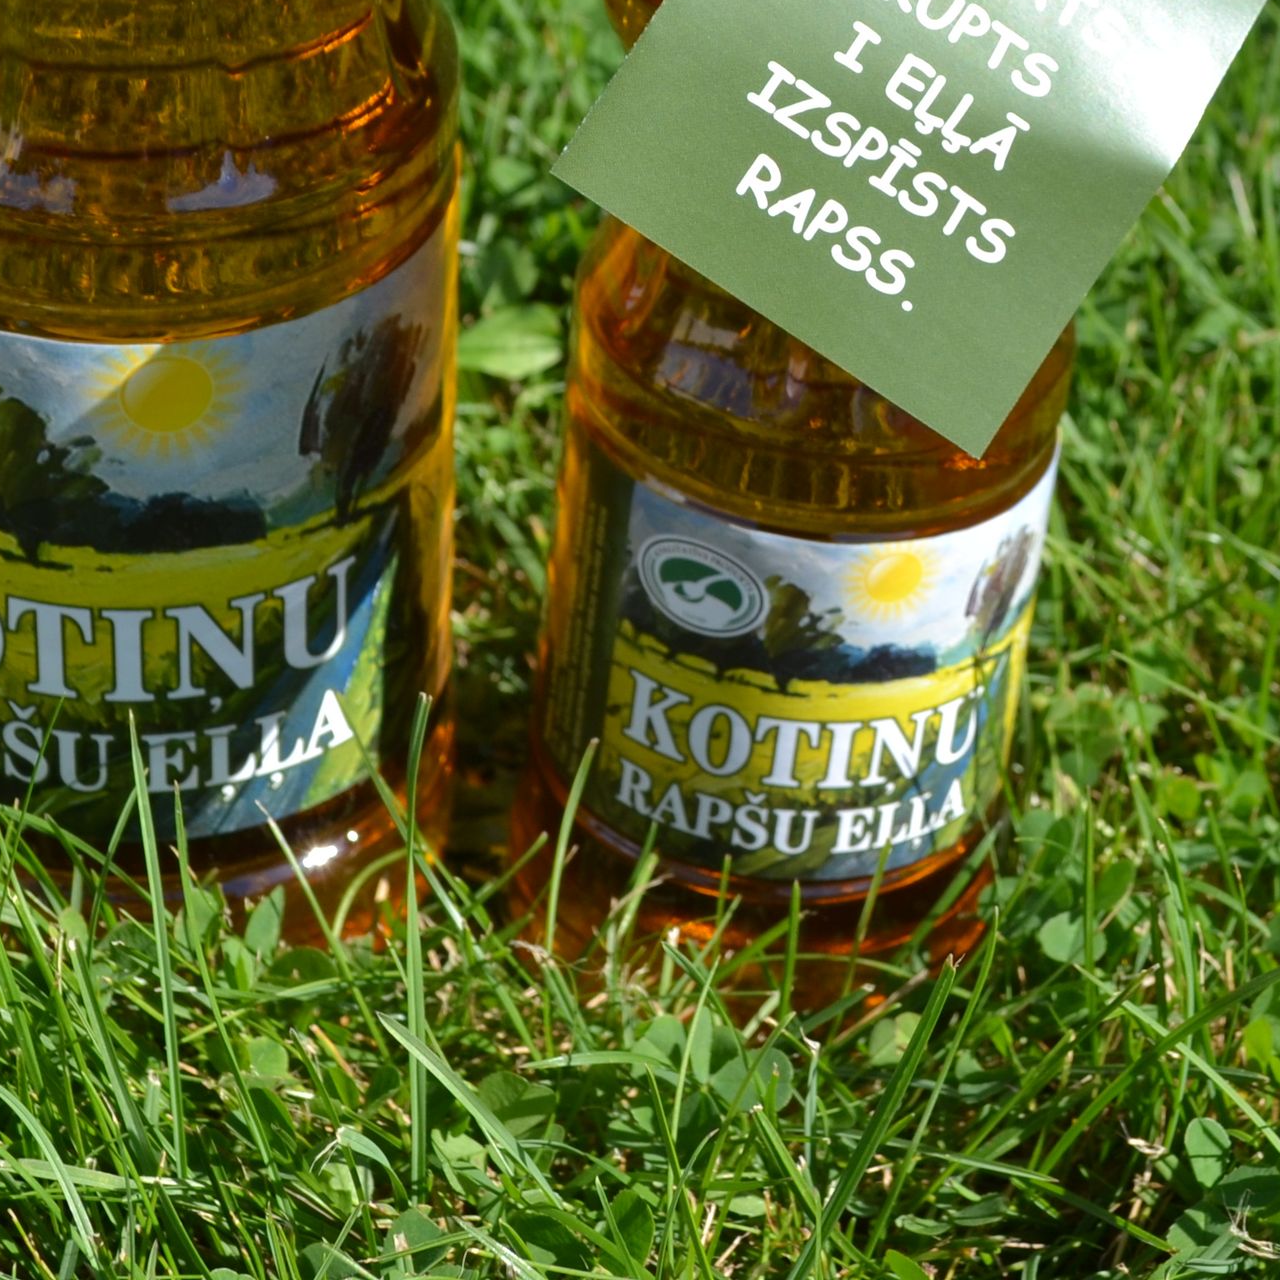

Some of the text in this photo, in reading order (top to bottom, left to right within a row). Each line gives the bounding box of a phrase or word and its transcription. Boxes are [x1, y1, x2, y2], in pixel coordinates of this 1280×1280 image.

[746, 60, 1017, 265] IZSPĪSTS
[833, 20, 1031, 172] I EĻĻĀ
[735, 153, 916, 313] RAPSS.
[143, 688, 354, 802] EĻĻA
[624, 669, 985, 795] KOTIŅU
[616, 757, 819, 855] RAPŠU
